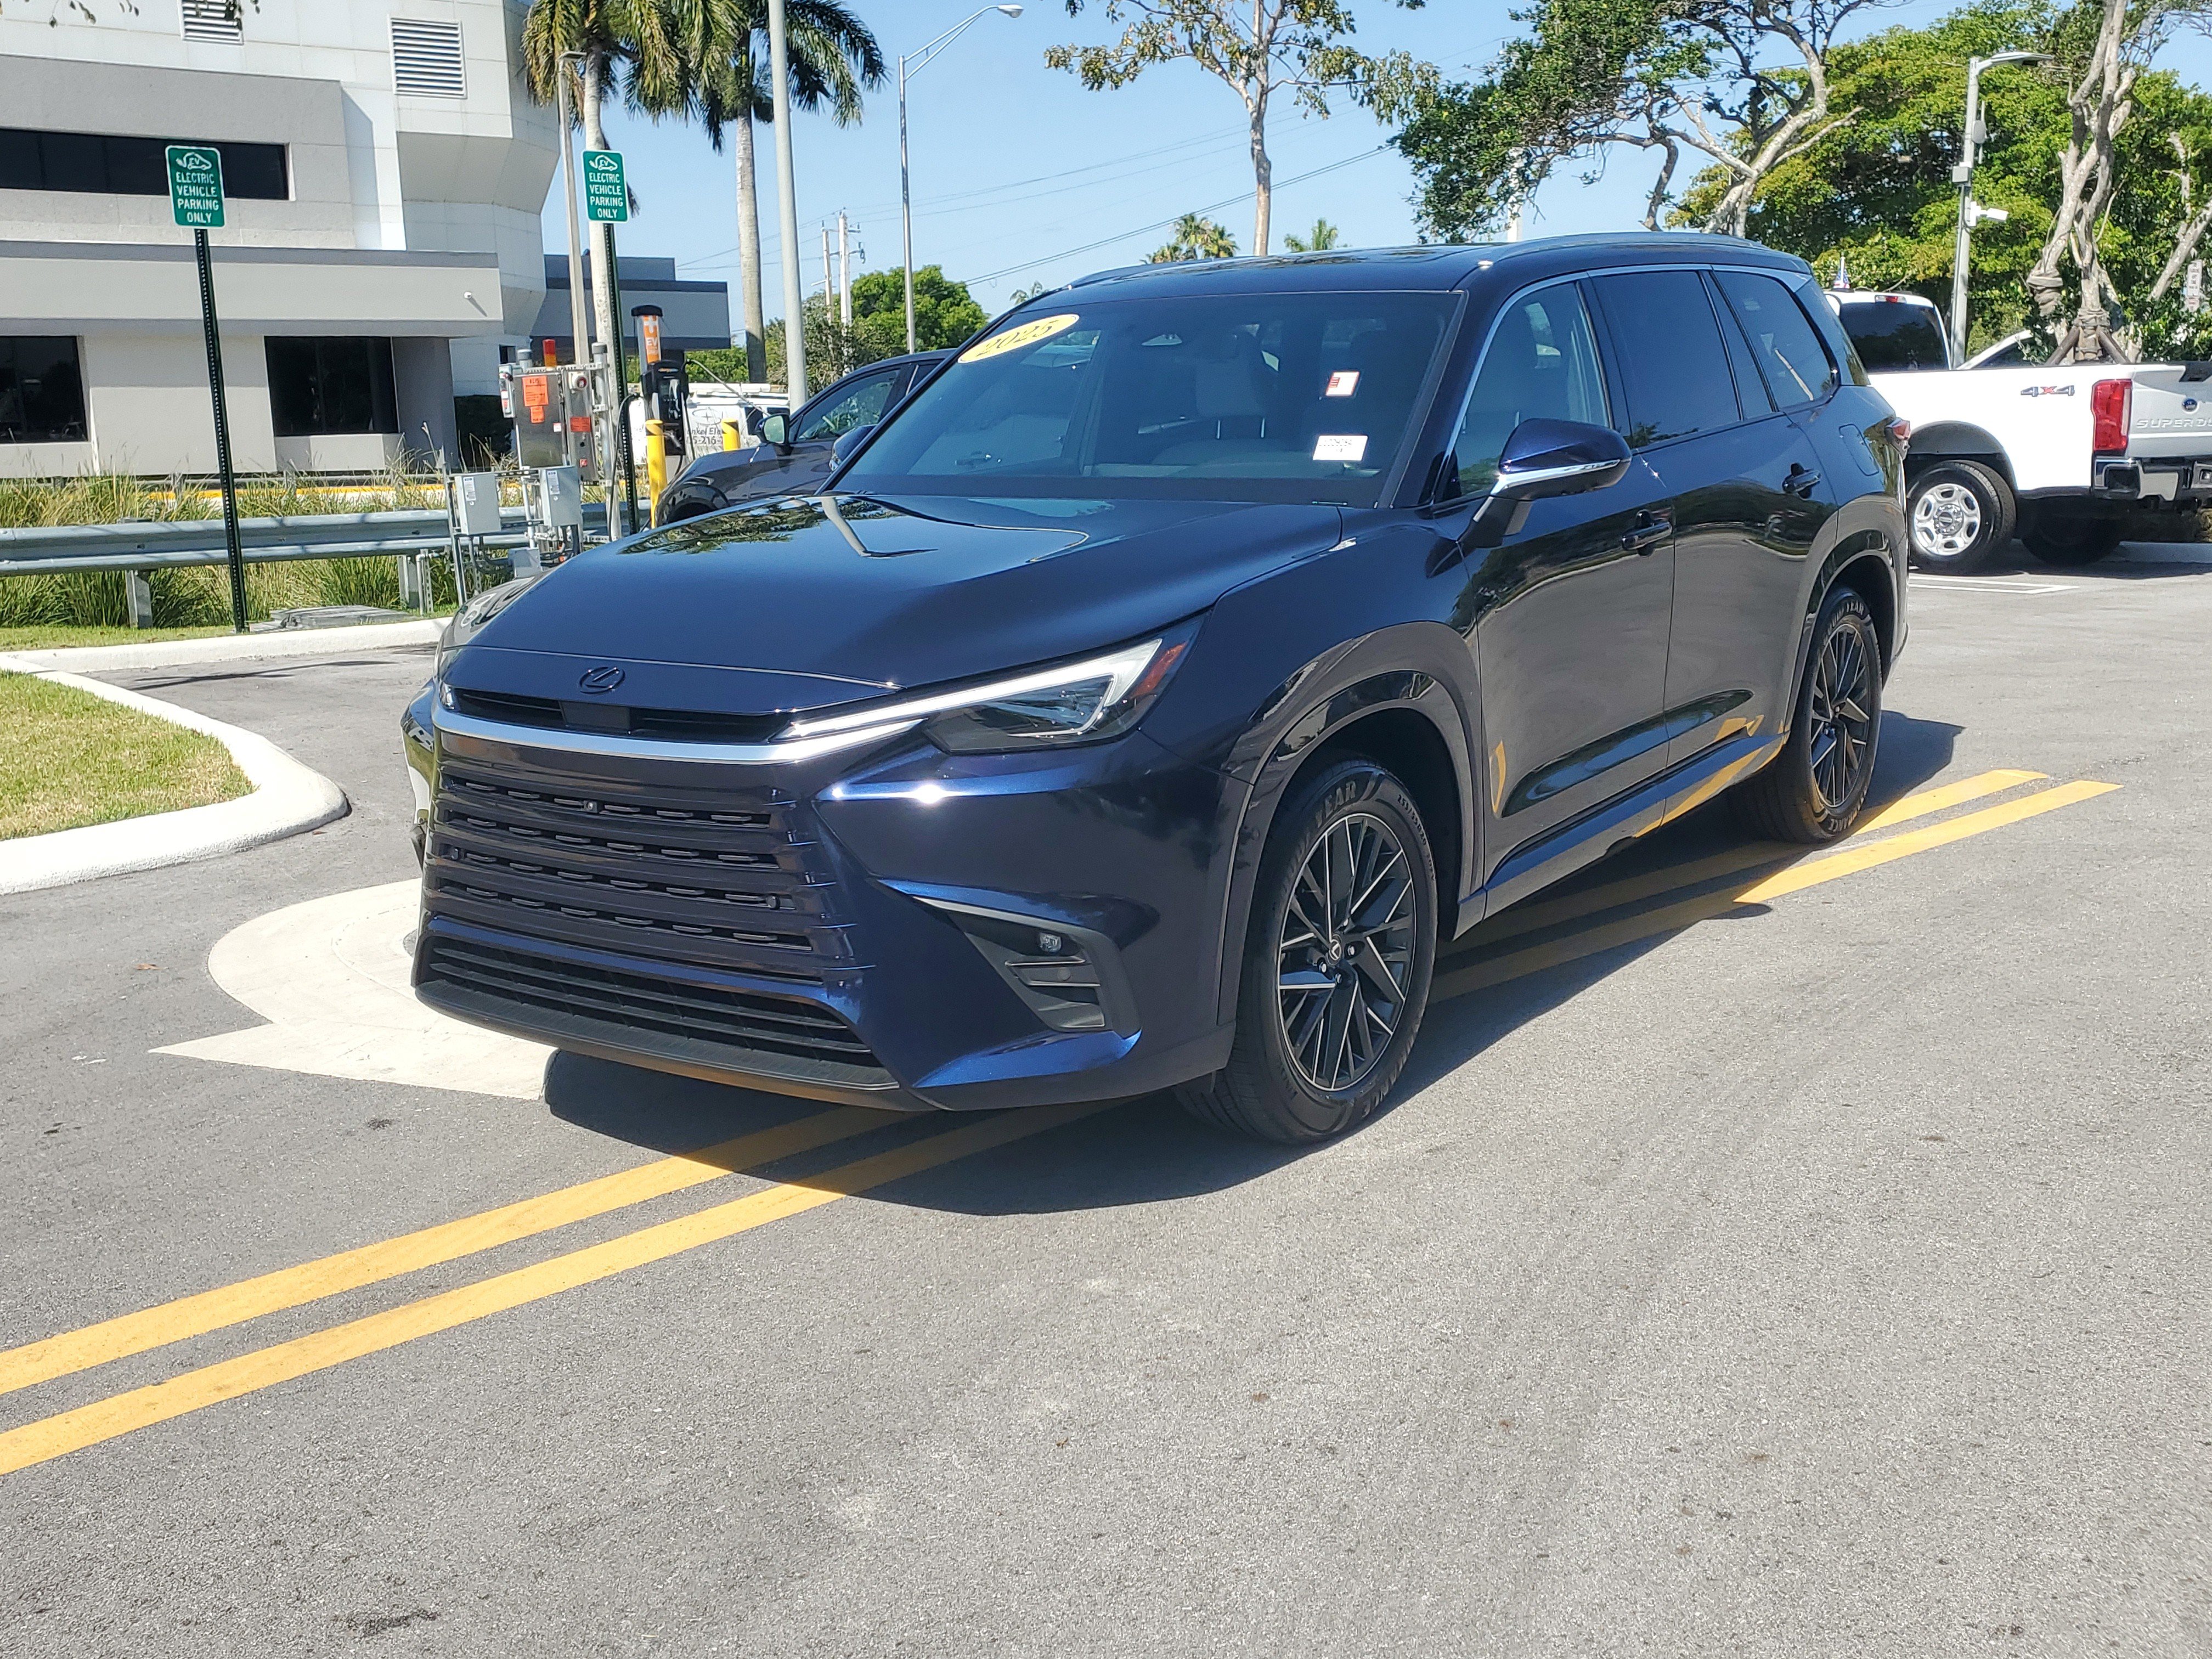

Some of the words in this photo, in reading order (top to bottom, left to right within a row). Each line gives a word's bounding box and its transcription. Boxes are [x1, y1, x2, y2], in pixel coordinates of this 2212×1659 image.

[176, 172, 215, 184] ELECTRIC
[589, 172, 620, 183] ELECTRIC
[176, 185, 217, 197] VEHICLE
[589, 184, 622, 195] VEHICLE
[177, 198, 219, 211] PARKING
[590, 196, 623, 207] PARKING
[187, 212, 212, 223] ONLY
[597, 208, 618, 218] ONLY
[645, 337, 657, 346] EV
[976, 319, 1059, 357] 2025
[2136, 419, 2193, 428] SUPER
